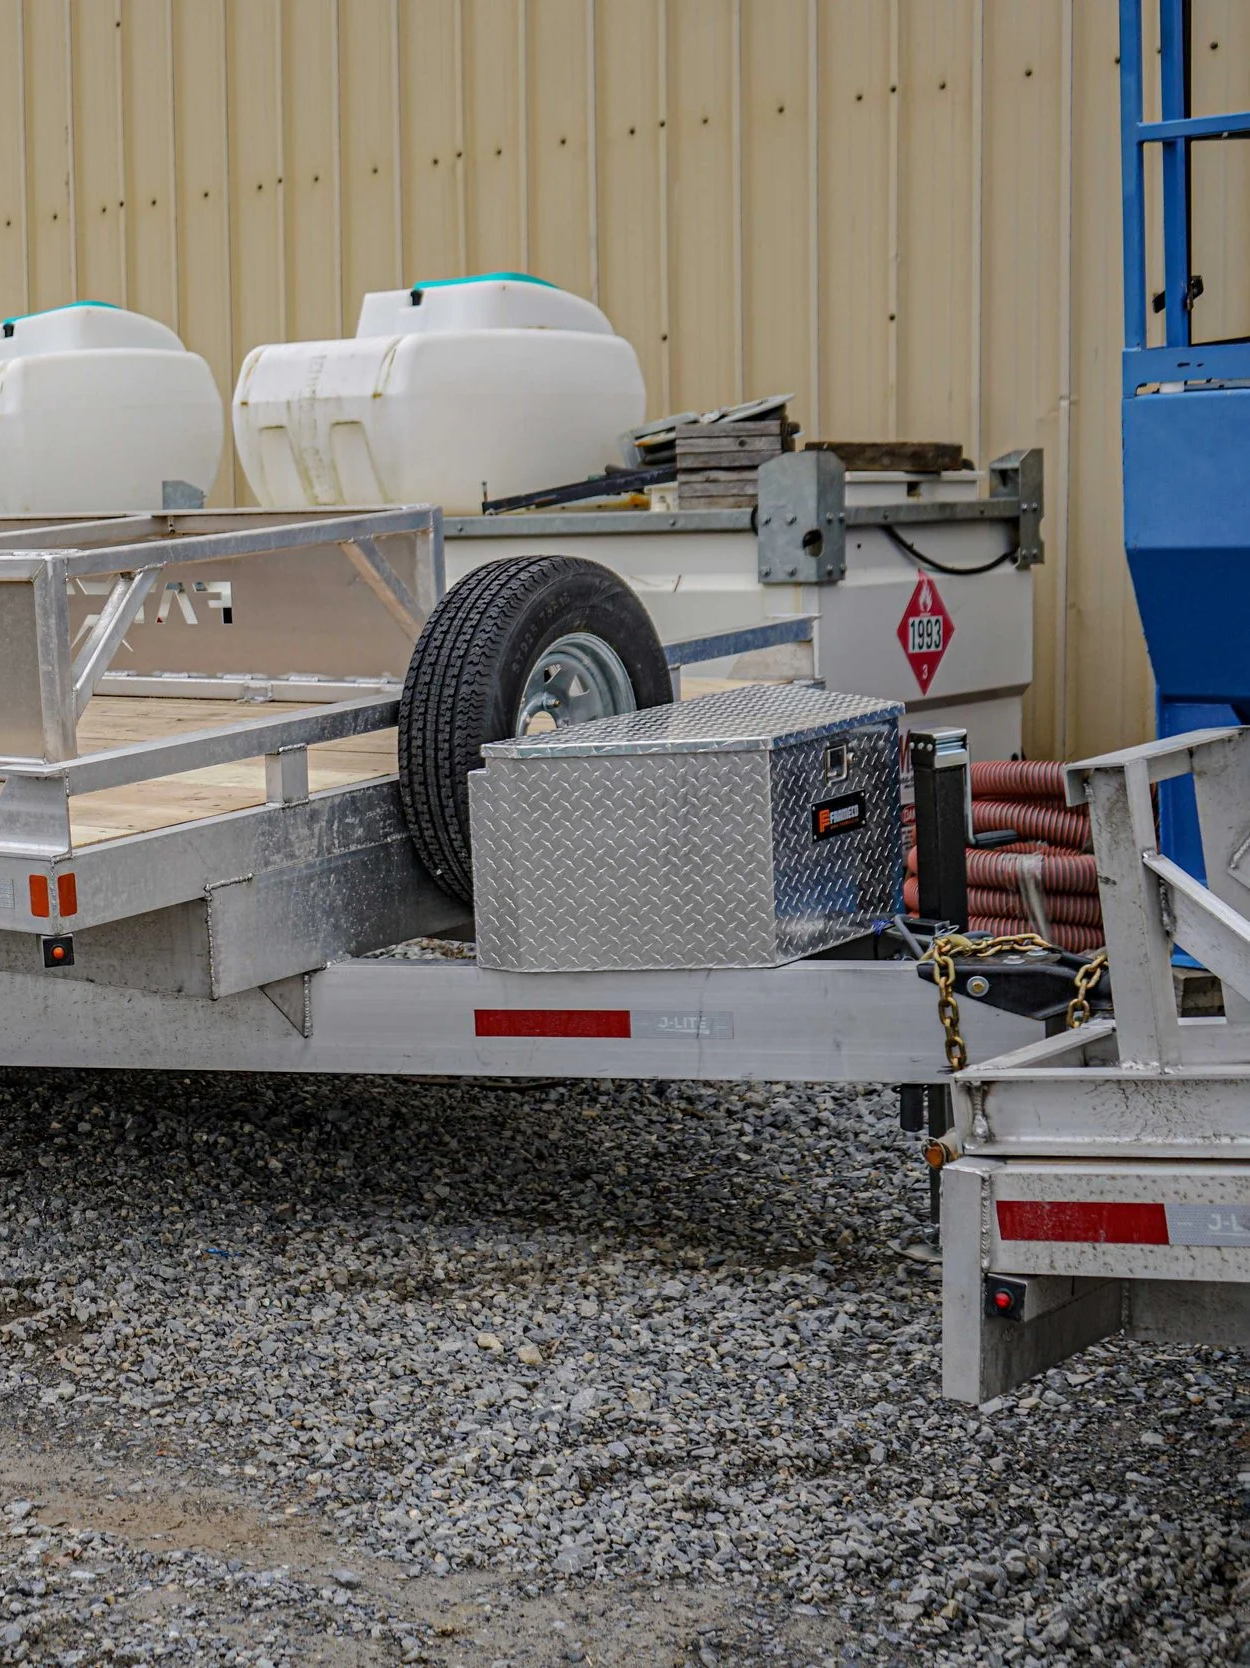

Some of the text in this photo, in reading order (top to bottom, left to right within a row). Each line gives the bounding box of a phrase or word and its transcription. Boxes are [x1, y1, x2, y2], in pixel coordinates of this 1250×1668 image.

[910, 618, 942, 651] 1993
[922, 663, 929, 680] 3
[657, 1016, 708, 1029] J-LITE
